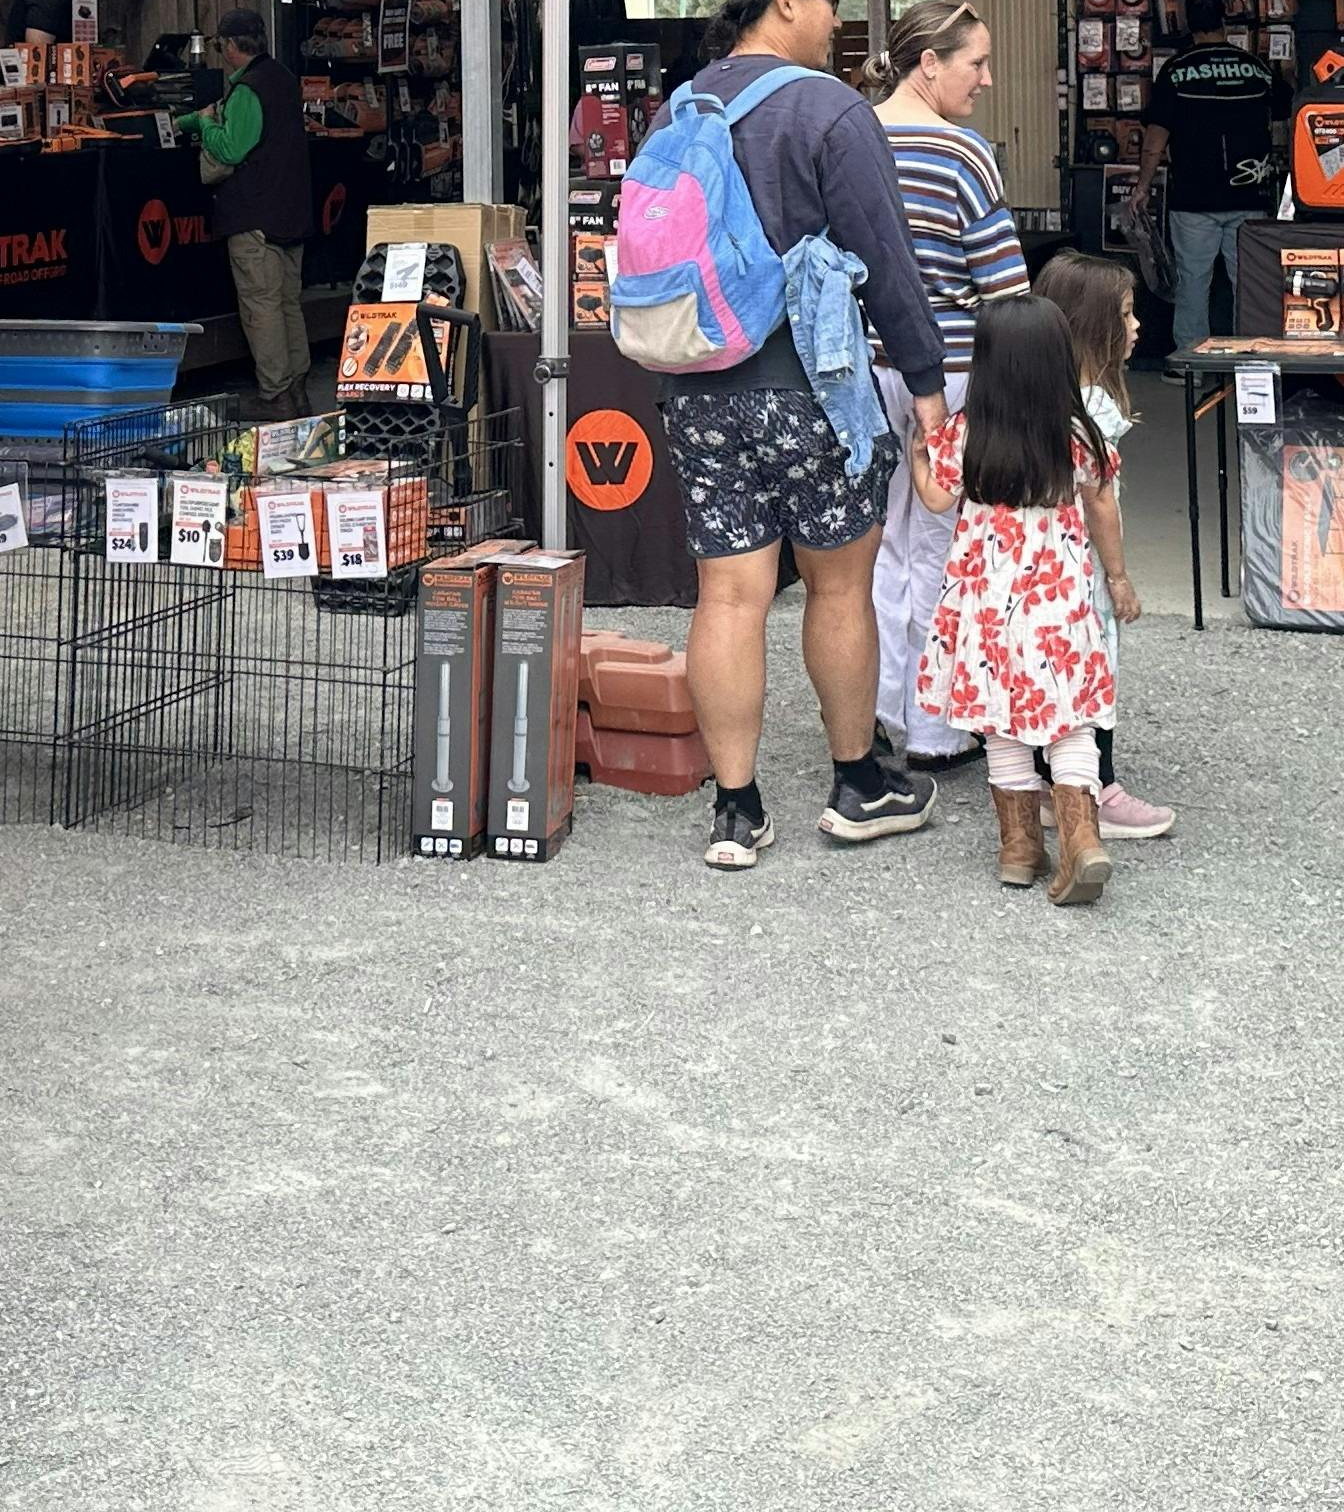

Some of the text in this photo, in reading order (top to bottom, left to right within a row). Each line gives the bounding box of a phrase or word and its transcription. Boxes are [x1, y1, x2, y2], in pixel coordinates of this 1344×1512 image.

[383, 32, 405, 50] FREE
[599, 81, 619, 92] FAN
[582, 216, 603, 226] FAN
[360, 311, 398, 319] WILDTRAK
[354, 383, 396, 392] RECOVERY
[178, 528, 200, 543] $10
[111, 538, 132, 551] $24
[273, 548, 295, 563] $39
[341, 553, 363, 567] $18
